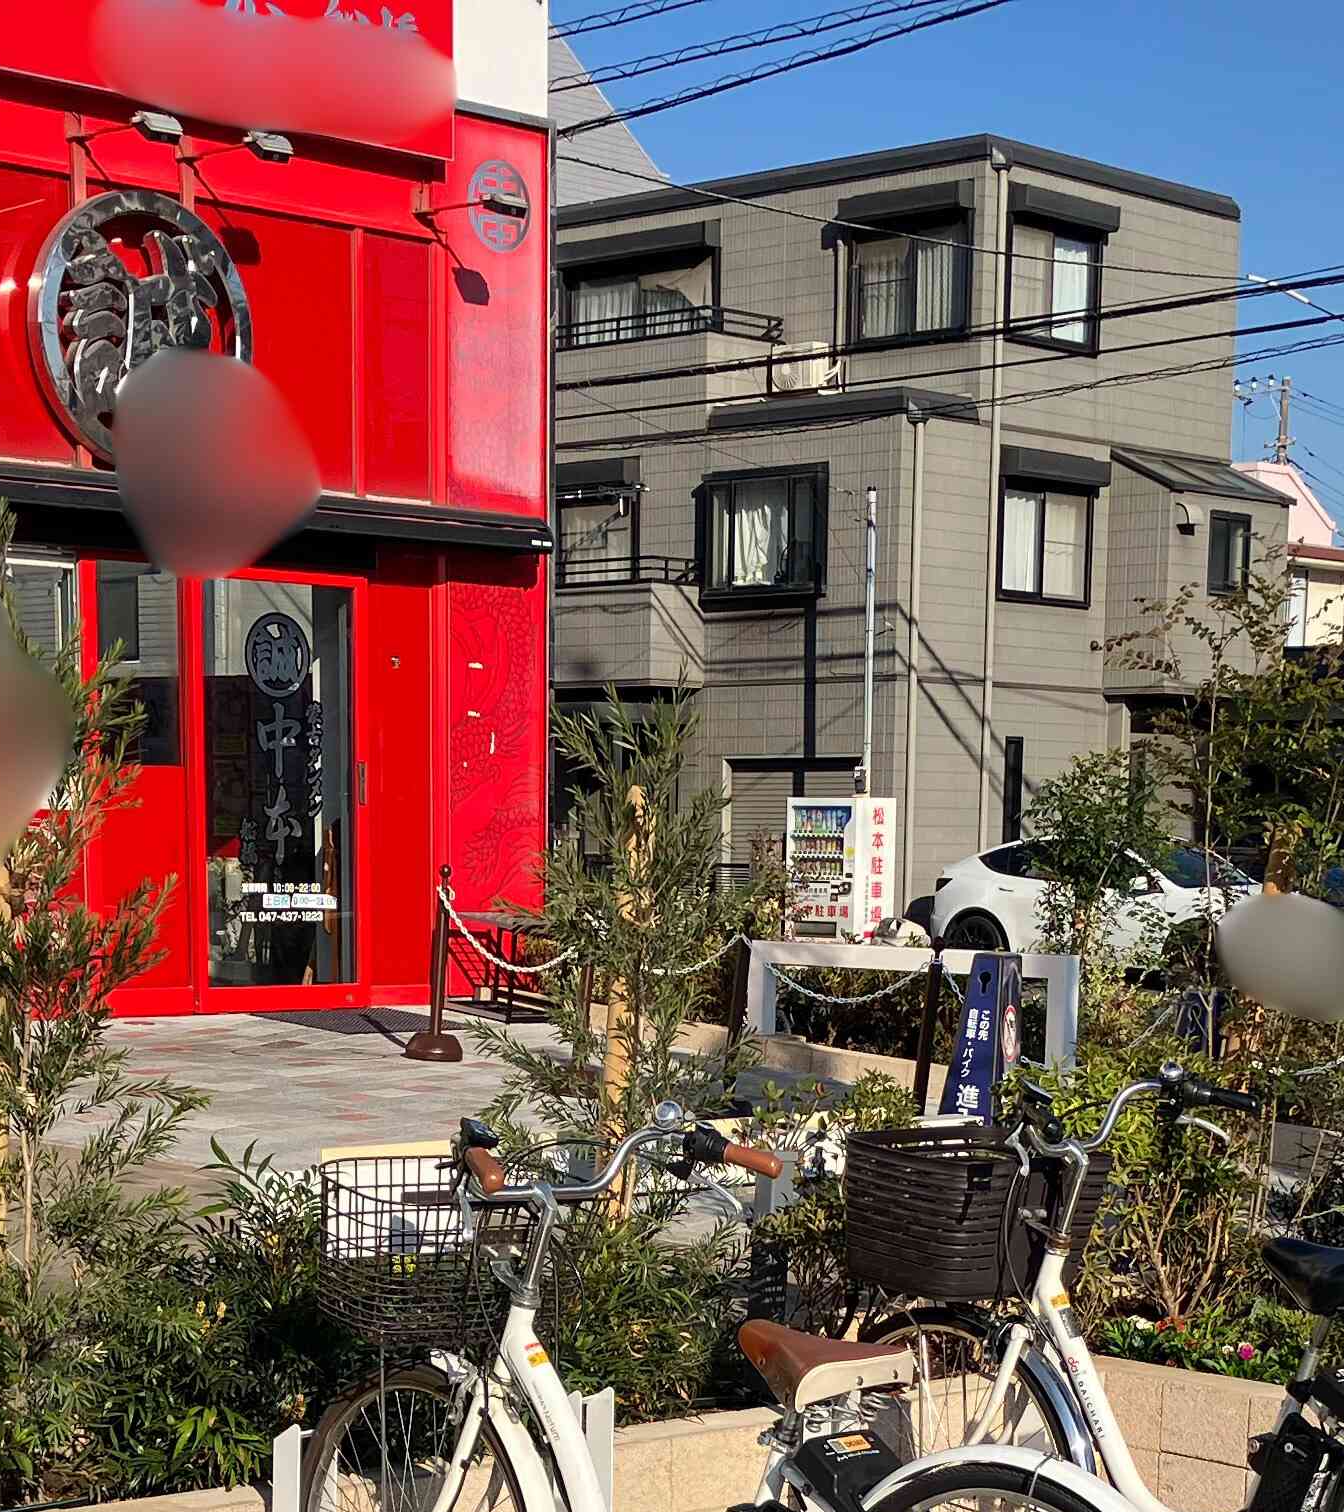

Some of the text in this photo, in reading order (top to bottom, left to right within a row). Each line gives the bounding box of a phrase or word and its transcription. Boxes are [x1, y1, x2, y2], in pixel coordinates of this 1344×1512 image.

[256, 702, 303, 866] 中本
[240, 911, 257, 922] TEL
[978, 1010, 991, 1041] この先
